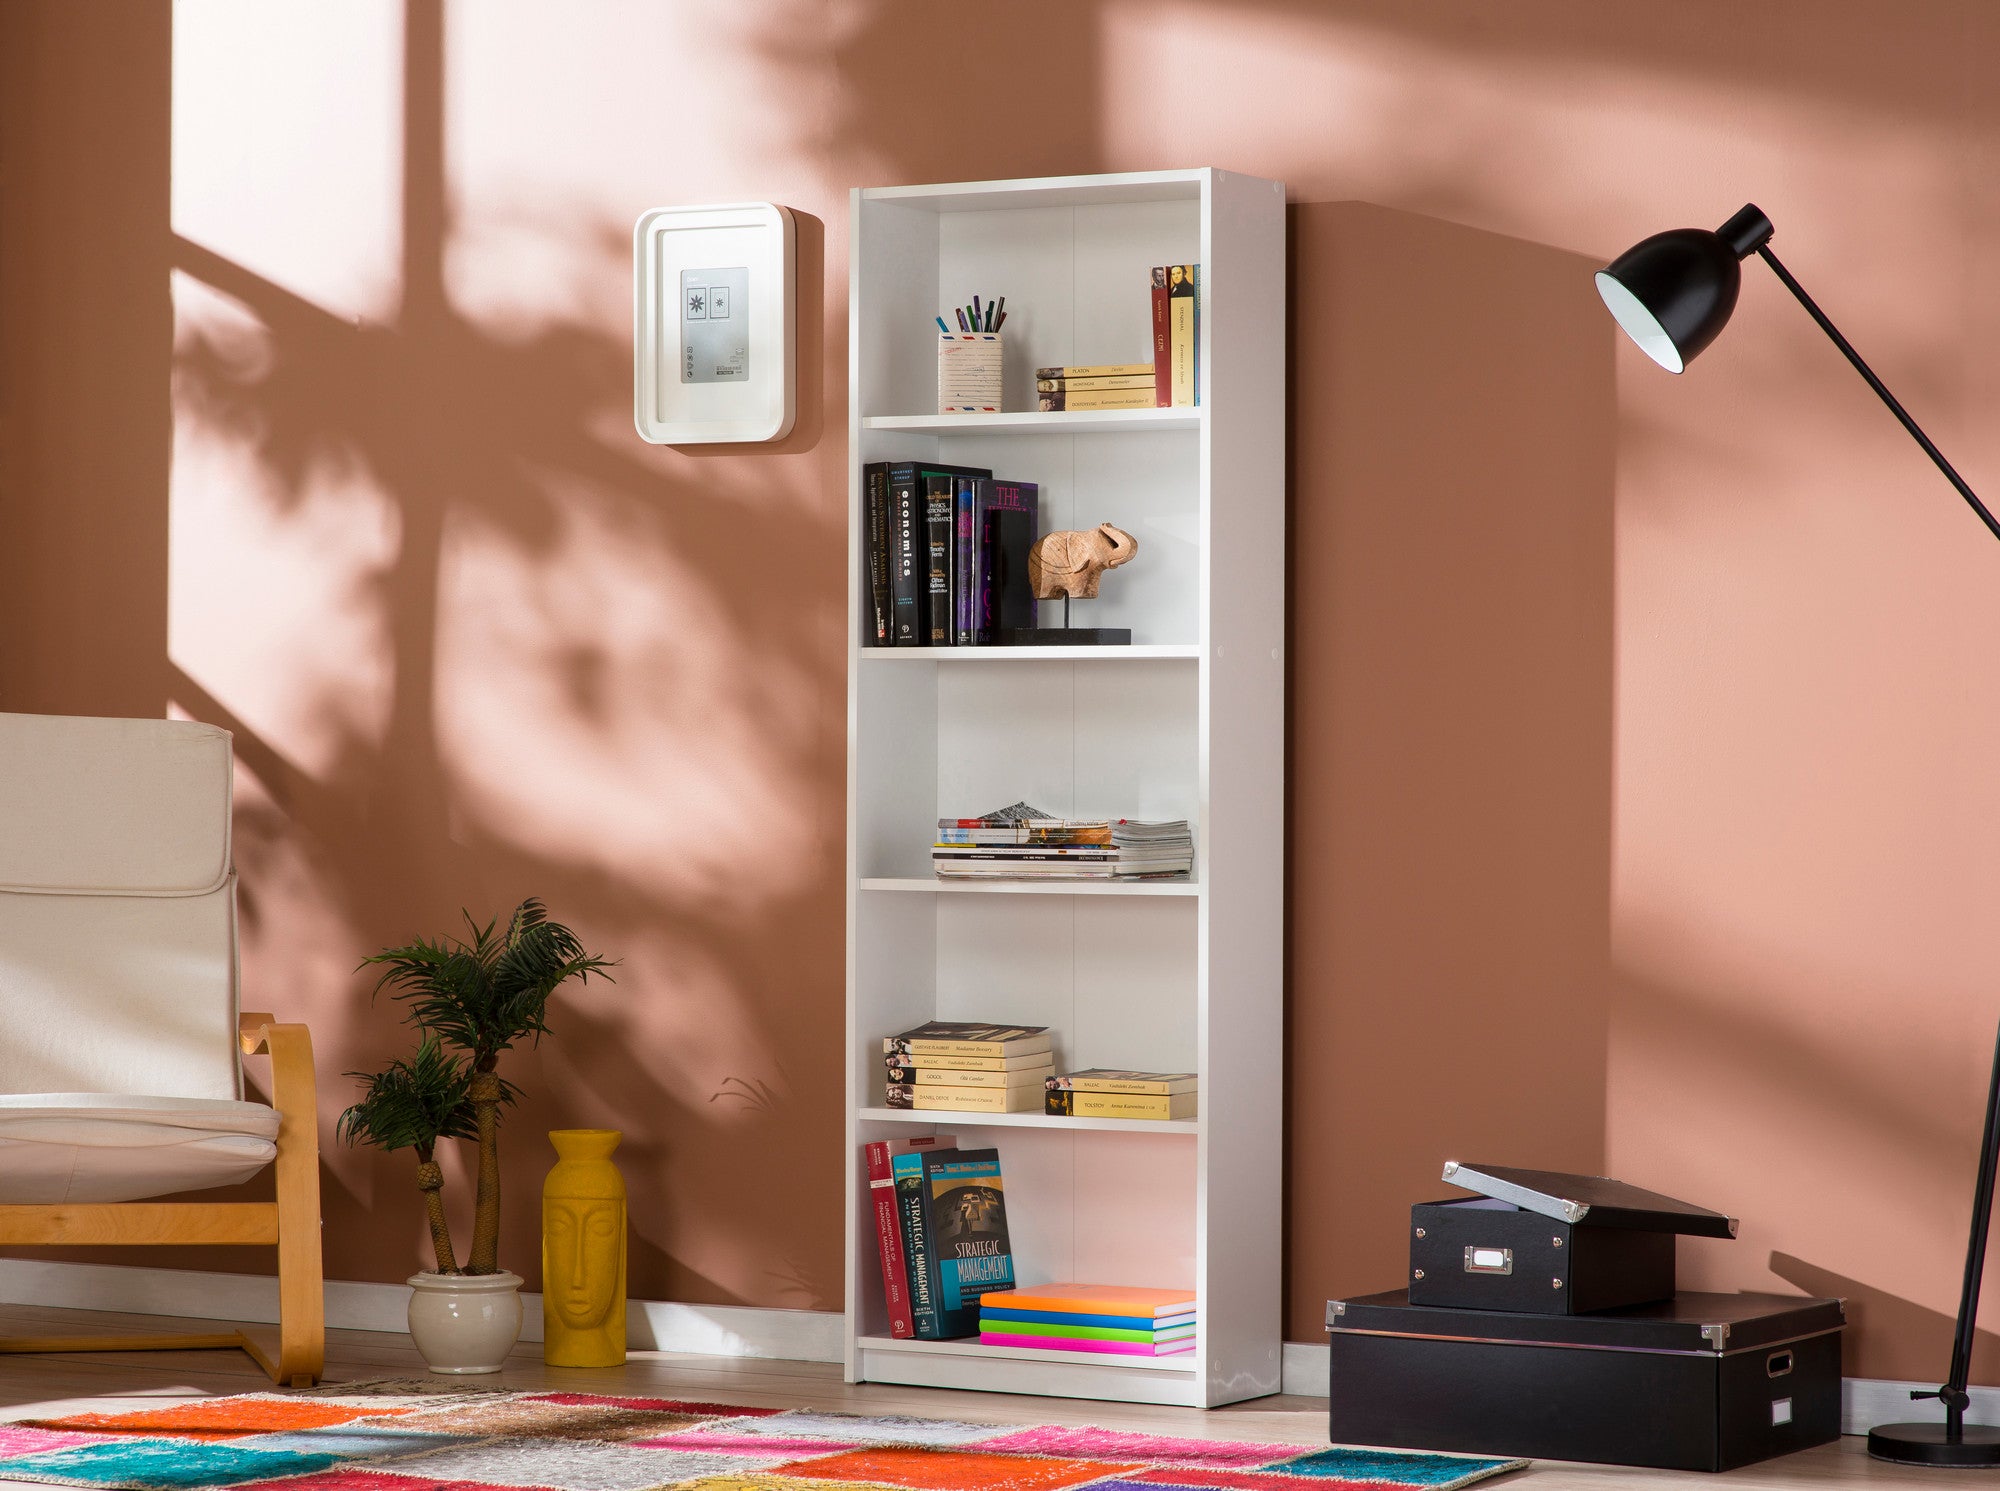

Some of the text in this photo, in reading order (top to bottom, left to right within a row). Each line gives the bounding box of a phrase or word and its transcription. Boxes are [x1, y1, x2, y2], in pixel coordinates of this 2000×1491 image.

[996, 486, 1020, 507] THE
[901, 490, 912, 577] economics
[878, 1202, 894, 1280] FINANCIAL MANAGEMENT
[884, 1201, 897, 1262] FUNDAMENTALS OF
[910, 1197, 930, 1304] STRATEGIC MANAGEMENT
[955, 1239, 1001, 1258] STRATEGIC
[957, 1255, 1008, 1283] MANAGEMENT
